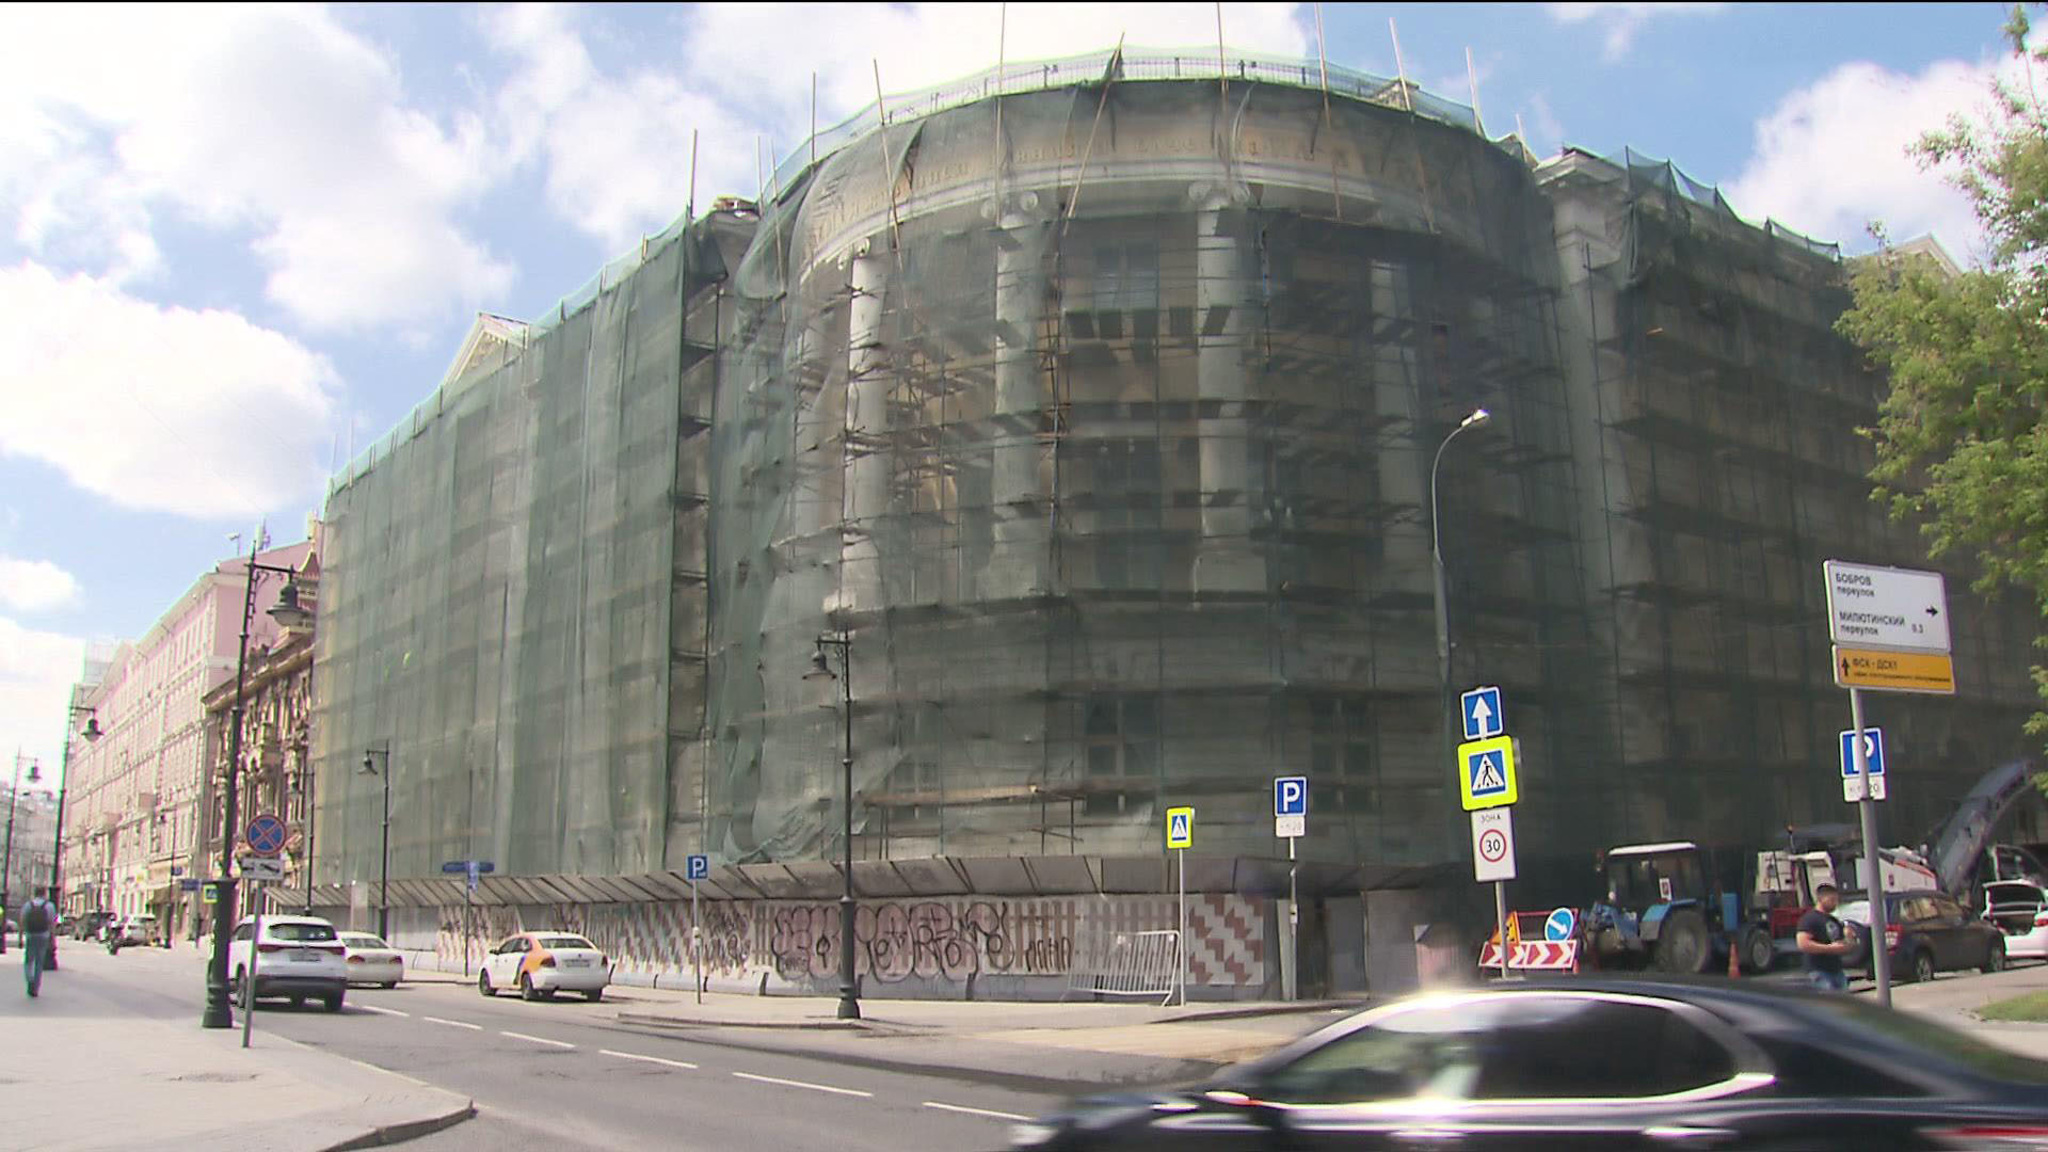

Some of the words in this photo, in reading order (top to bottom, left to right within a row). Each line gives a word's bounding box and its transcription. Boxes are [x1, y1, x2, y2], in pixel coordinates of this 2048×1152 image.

[1836, 573, 1871, 586] БОБРОВ
[1837, 586, 1874, 598] переулок
[1839, 611, 1905, 626] МИЛЮТИНСКИЙ
[1841, 624, 1878, 637] переулок
[1283, 782, 1300, 812] P
[1486, 839, 1501, 853] 30
[692, 857, 705, 878] P
